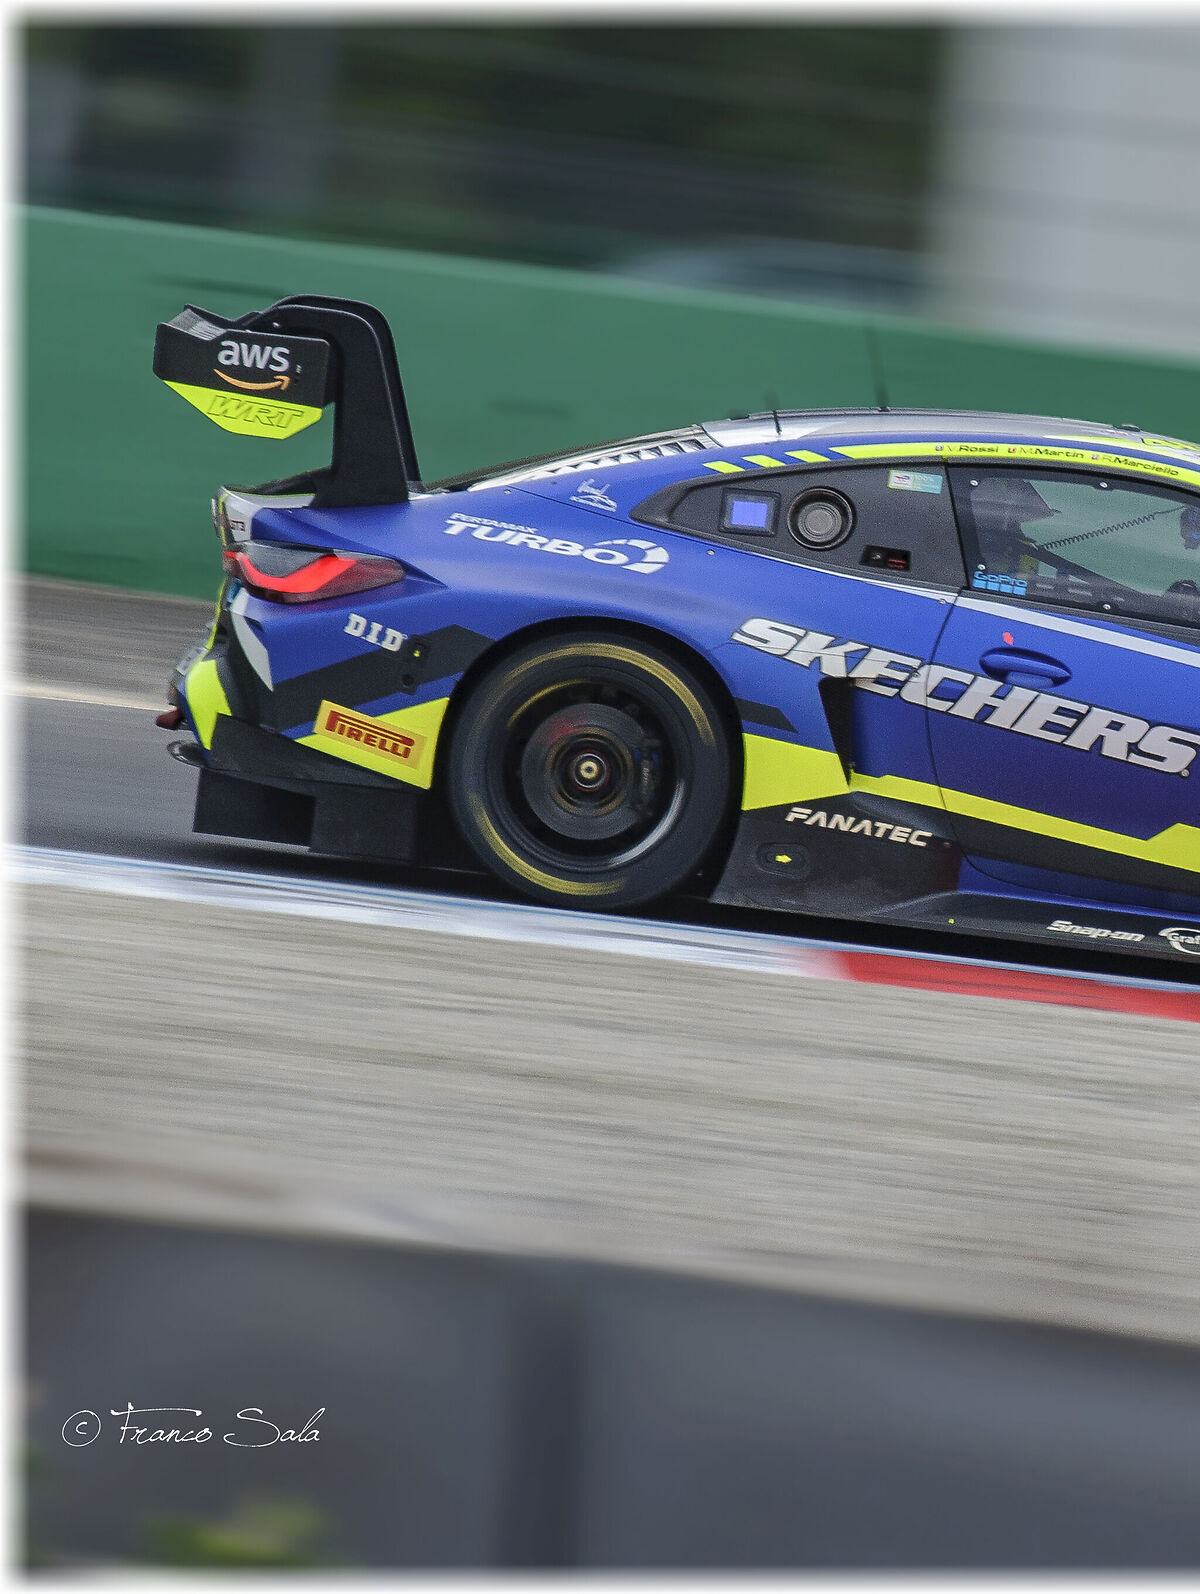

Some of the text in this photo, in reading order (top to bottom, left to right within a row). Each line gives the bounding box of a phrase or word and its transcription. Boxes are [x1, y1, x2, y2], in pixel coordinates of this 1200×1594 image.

[218, 340, 290, 372] aws
[207, 395, 304, 428] WRT
[443, 520, 629, 565] TURBO
[973, 571, 1028, 587] GoPro
[325, 710, 415, 759] PIRELLI
[785, 807, 937, 848] FANATEC
[1046, 920, 1146, 942] Snap-on
